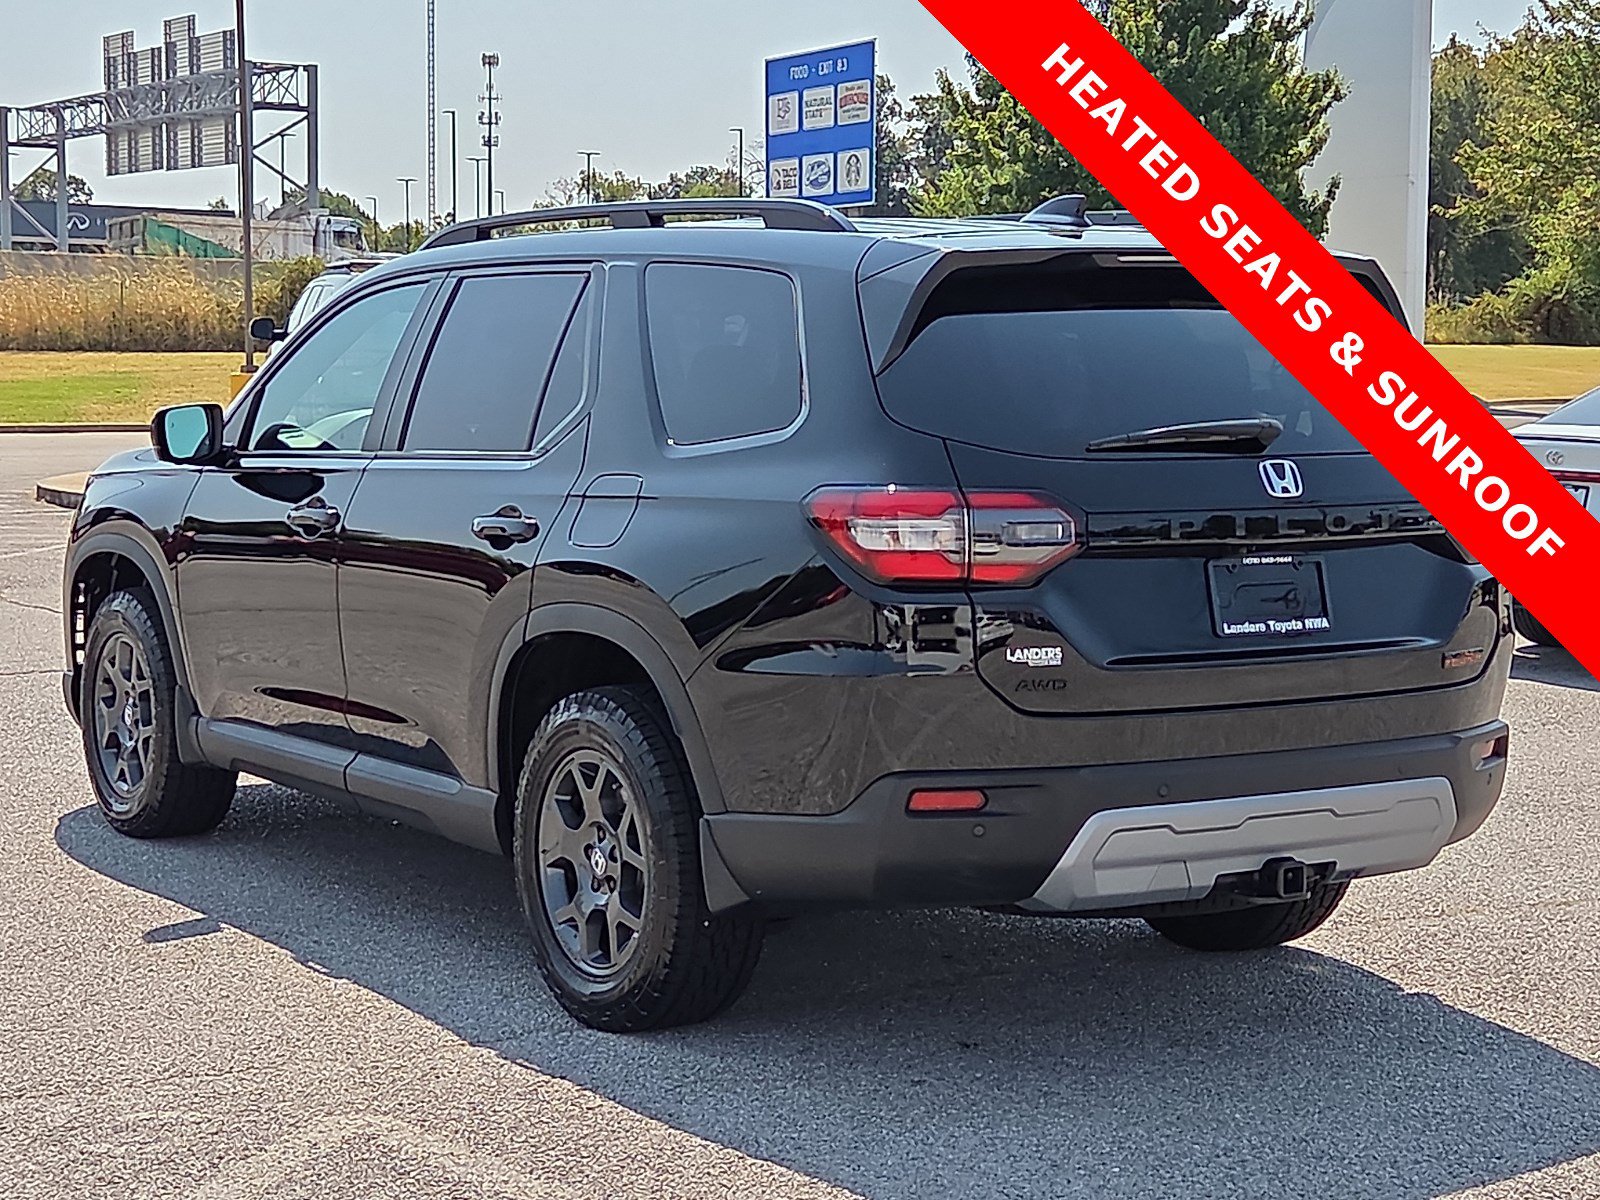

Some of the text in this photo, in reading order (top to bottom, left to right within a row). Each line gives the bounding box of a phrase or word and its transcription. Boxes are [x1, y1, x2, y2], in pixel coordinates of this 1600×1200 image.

[1168, 509, 1396, 539] PILOT
[1267, 619, 1303, 633] Toyota
[1304, 617, 1330, 630] NWA
[1006, 646, 1063, 661] LANDERS
